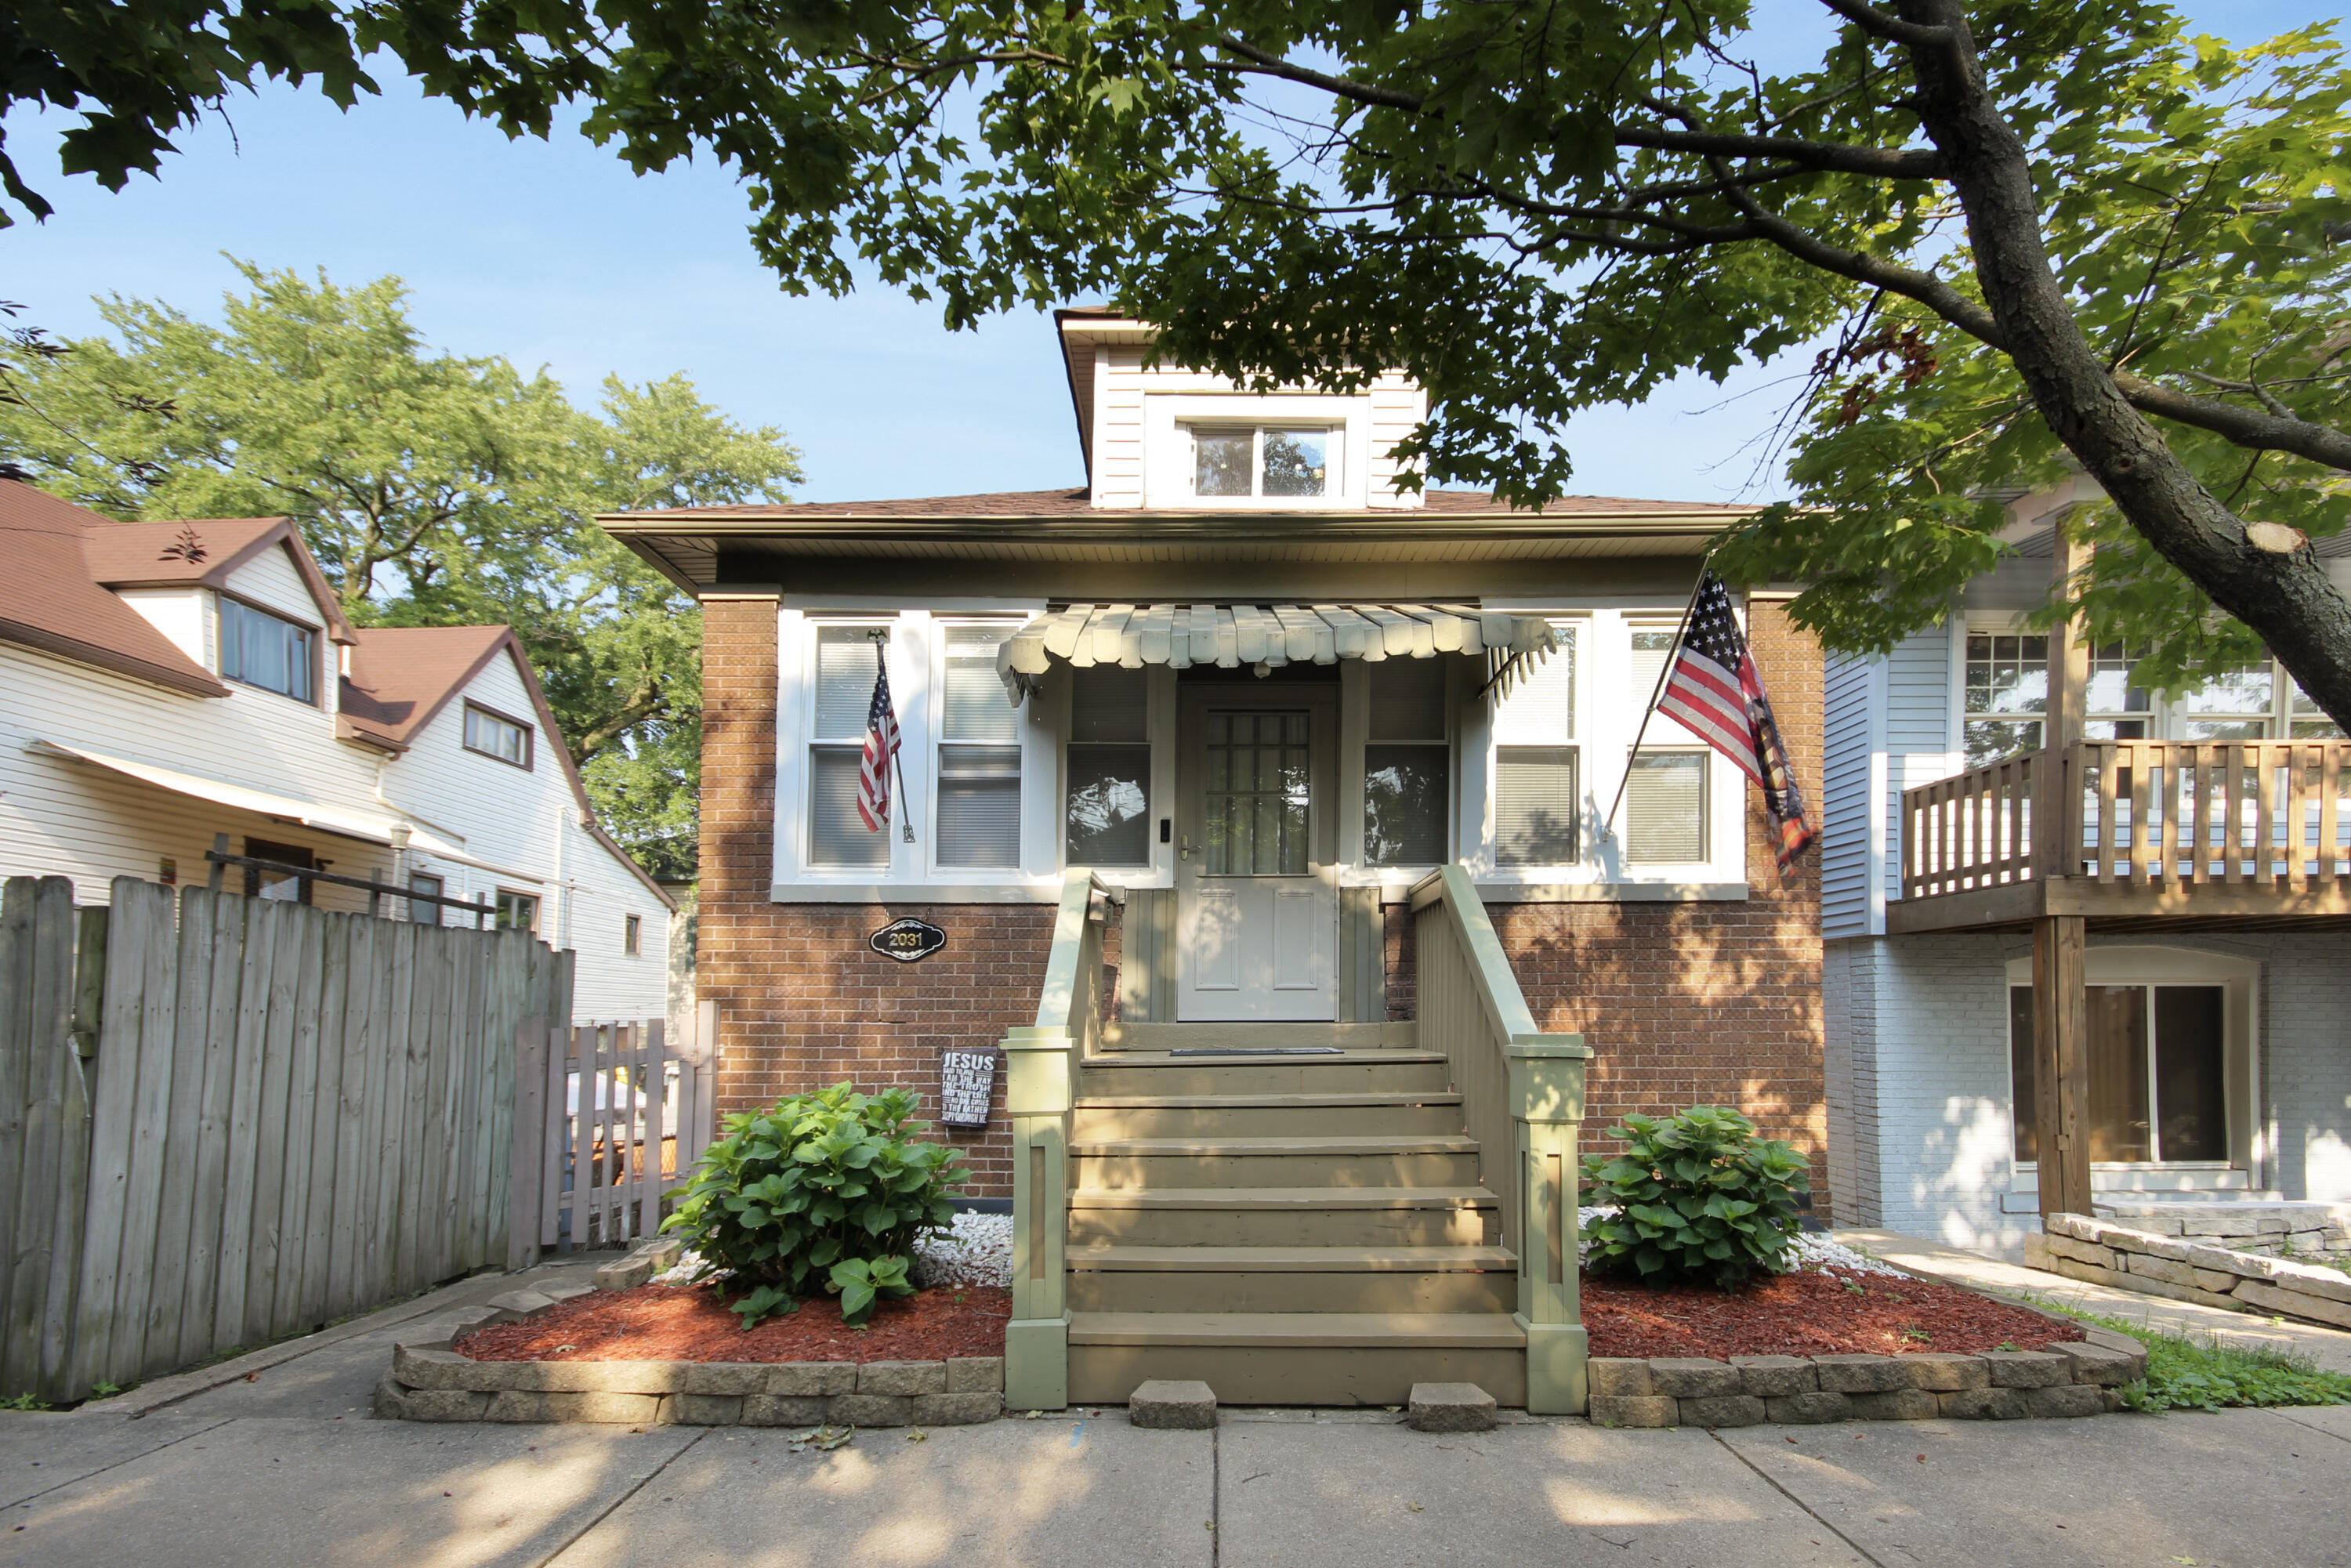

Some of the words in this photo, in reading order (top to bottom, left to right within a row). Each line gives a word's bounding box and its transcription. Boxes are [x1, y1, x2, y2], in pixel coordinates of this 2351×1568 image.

[889, 932, 922, 947] 2031
[943, 1052, 994, 1070] JESUS
[957, 1089, 970, 1098] THE
[949, 1103, 961, 1112] THE
[962, 1105, 988, 1114] FATHER
